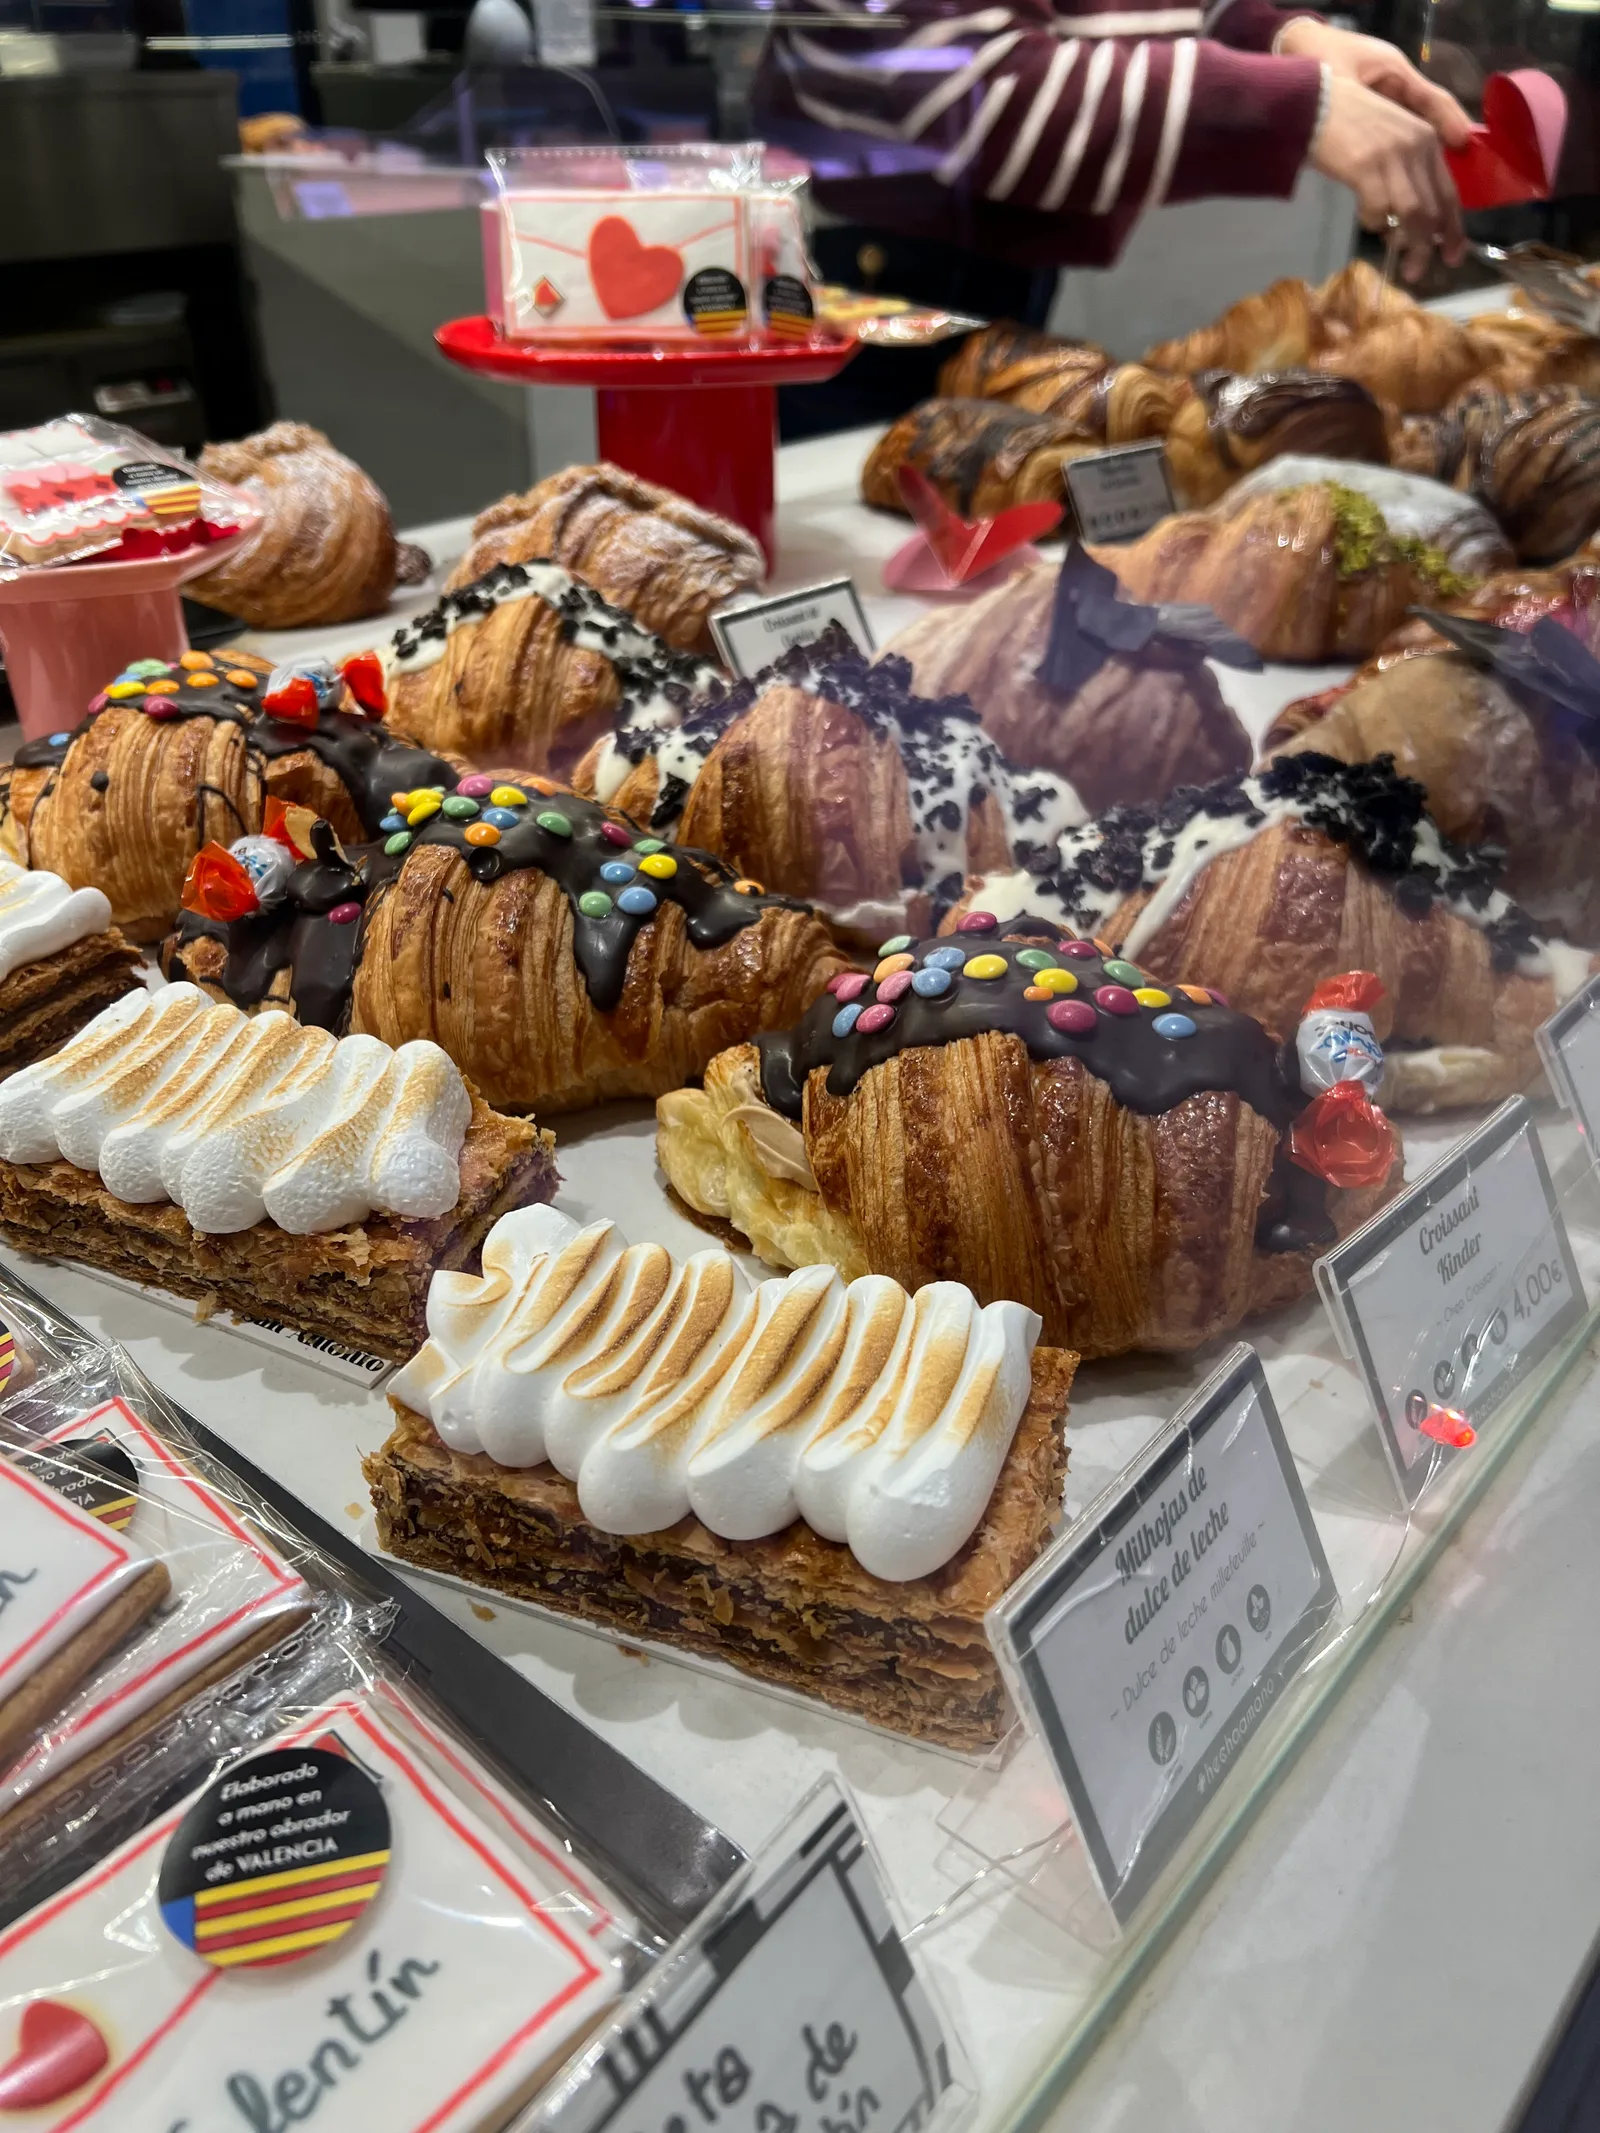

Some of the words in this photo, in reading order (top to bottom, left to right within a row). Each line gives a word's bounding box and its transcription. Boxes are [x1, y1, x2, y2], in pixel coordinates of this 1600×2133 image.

[1436, 1233, 1481, 1285] Kinder
[1513, 1258, 1562, 1320] 4,00€
[1115, 1489, 1188, 1586] Milhojas
[1187, 1466, 1208, 1502] de
[1124, 1576, 1169, 1644] dulce
[1171, 1549, 1191, 1588] de
[1189, 1502, 1229, 1561] leche
[1122, 1661, 1157, 1711] Dulce
[1160, 1636, 1176, 1664] de
[1176, 1596, 1208, 1641] leche
[219, 1762, 319, 1801] Elaborado
[217, 1811, 234, 1827] a
[234, 1796, 294, 1822] mano
[296, 1789, 323, 1807] en
[190, 1828, 268, 1860] nuestro
[269, 1809, 351, 1839] obrador
[205, 1860, 235, 1882] de
[234, 1836, 339, 1873] VALENCIA
